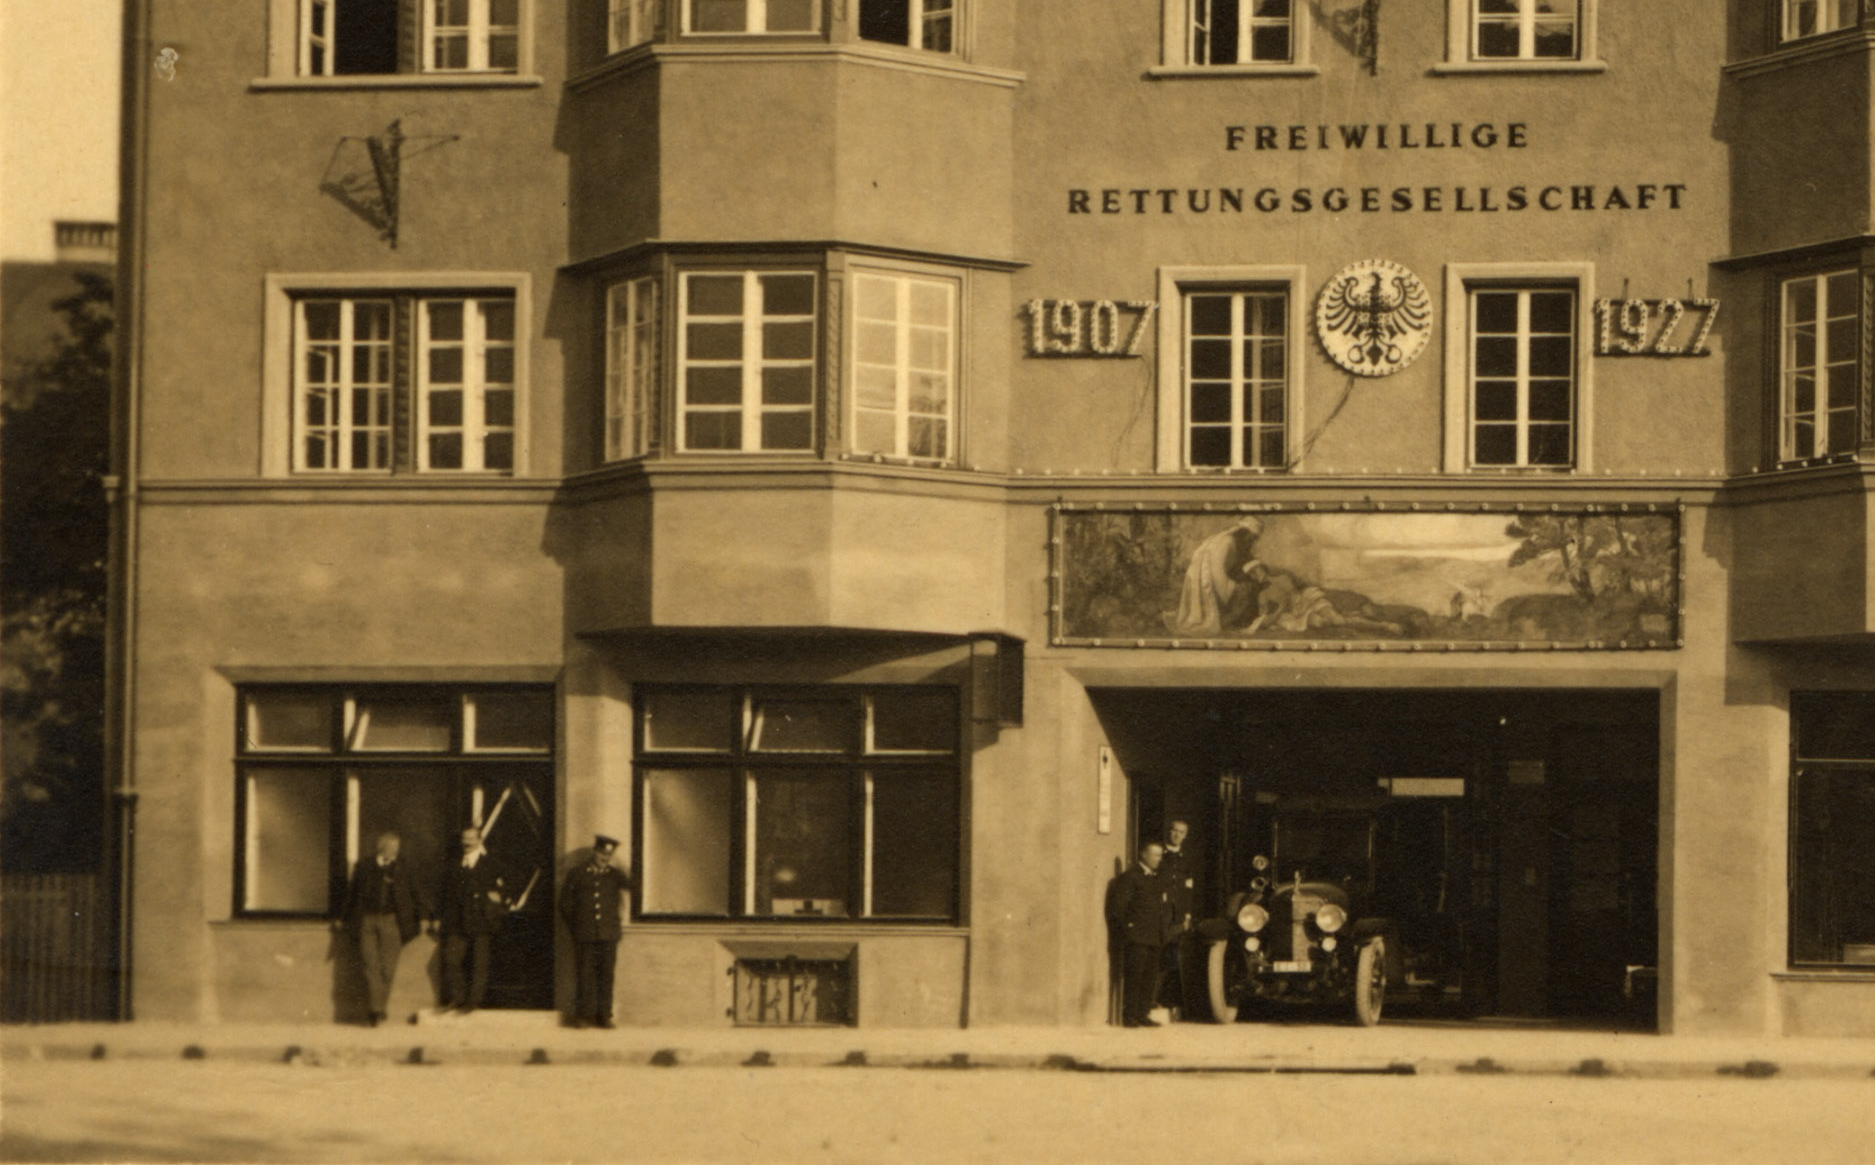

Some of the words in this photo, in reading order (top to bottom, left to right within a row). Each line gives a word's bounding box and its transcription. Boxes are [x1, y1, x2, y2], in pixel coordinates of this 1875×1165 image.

[1224, 122, 1530, 152] FREIWILLIGE
[1067, 182, 1689, 215] RETTUNGSGESELLSCHAFT
[1025, 298, 1157, 357] 1907
[1594, 297, 1721, 357] 1927
